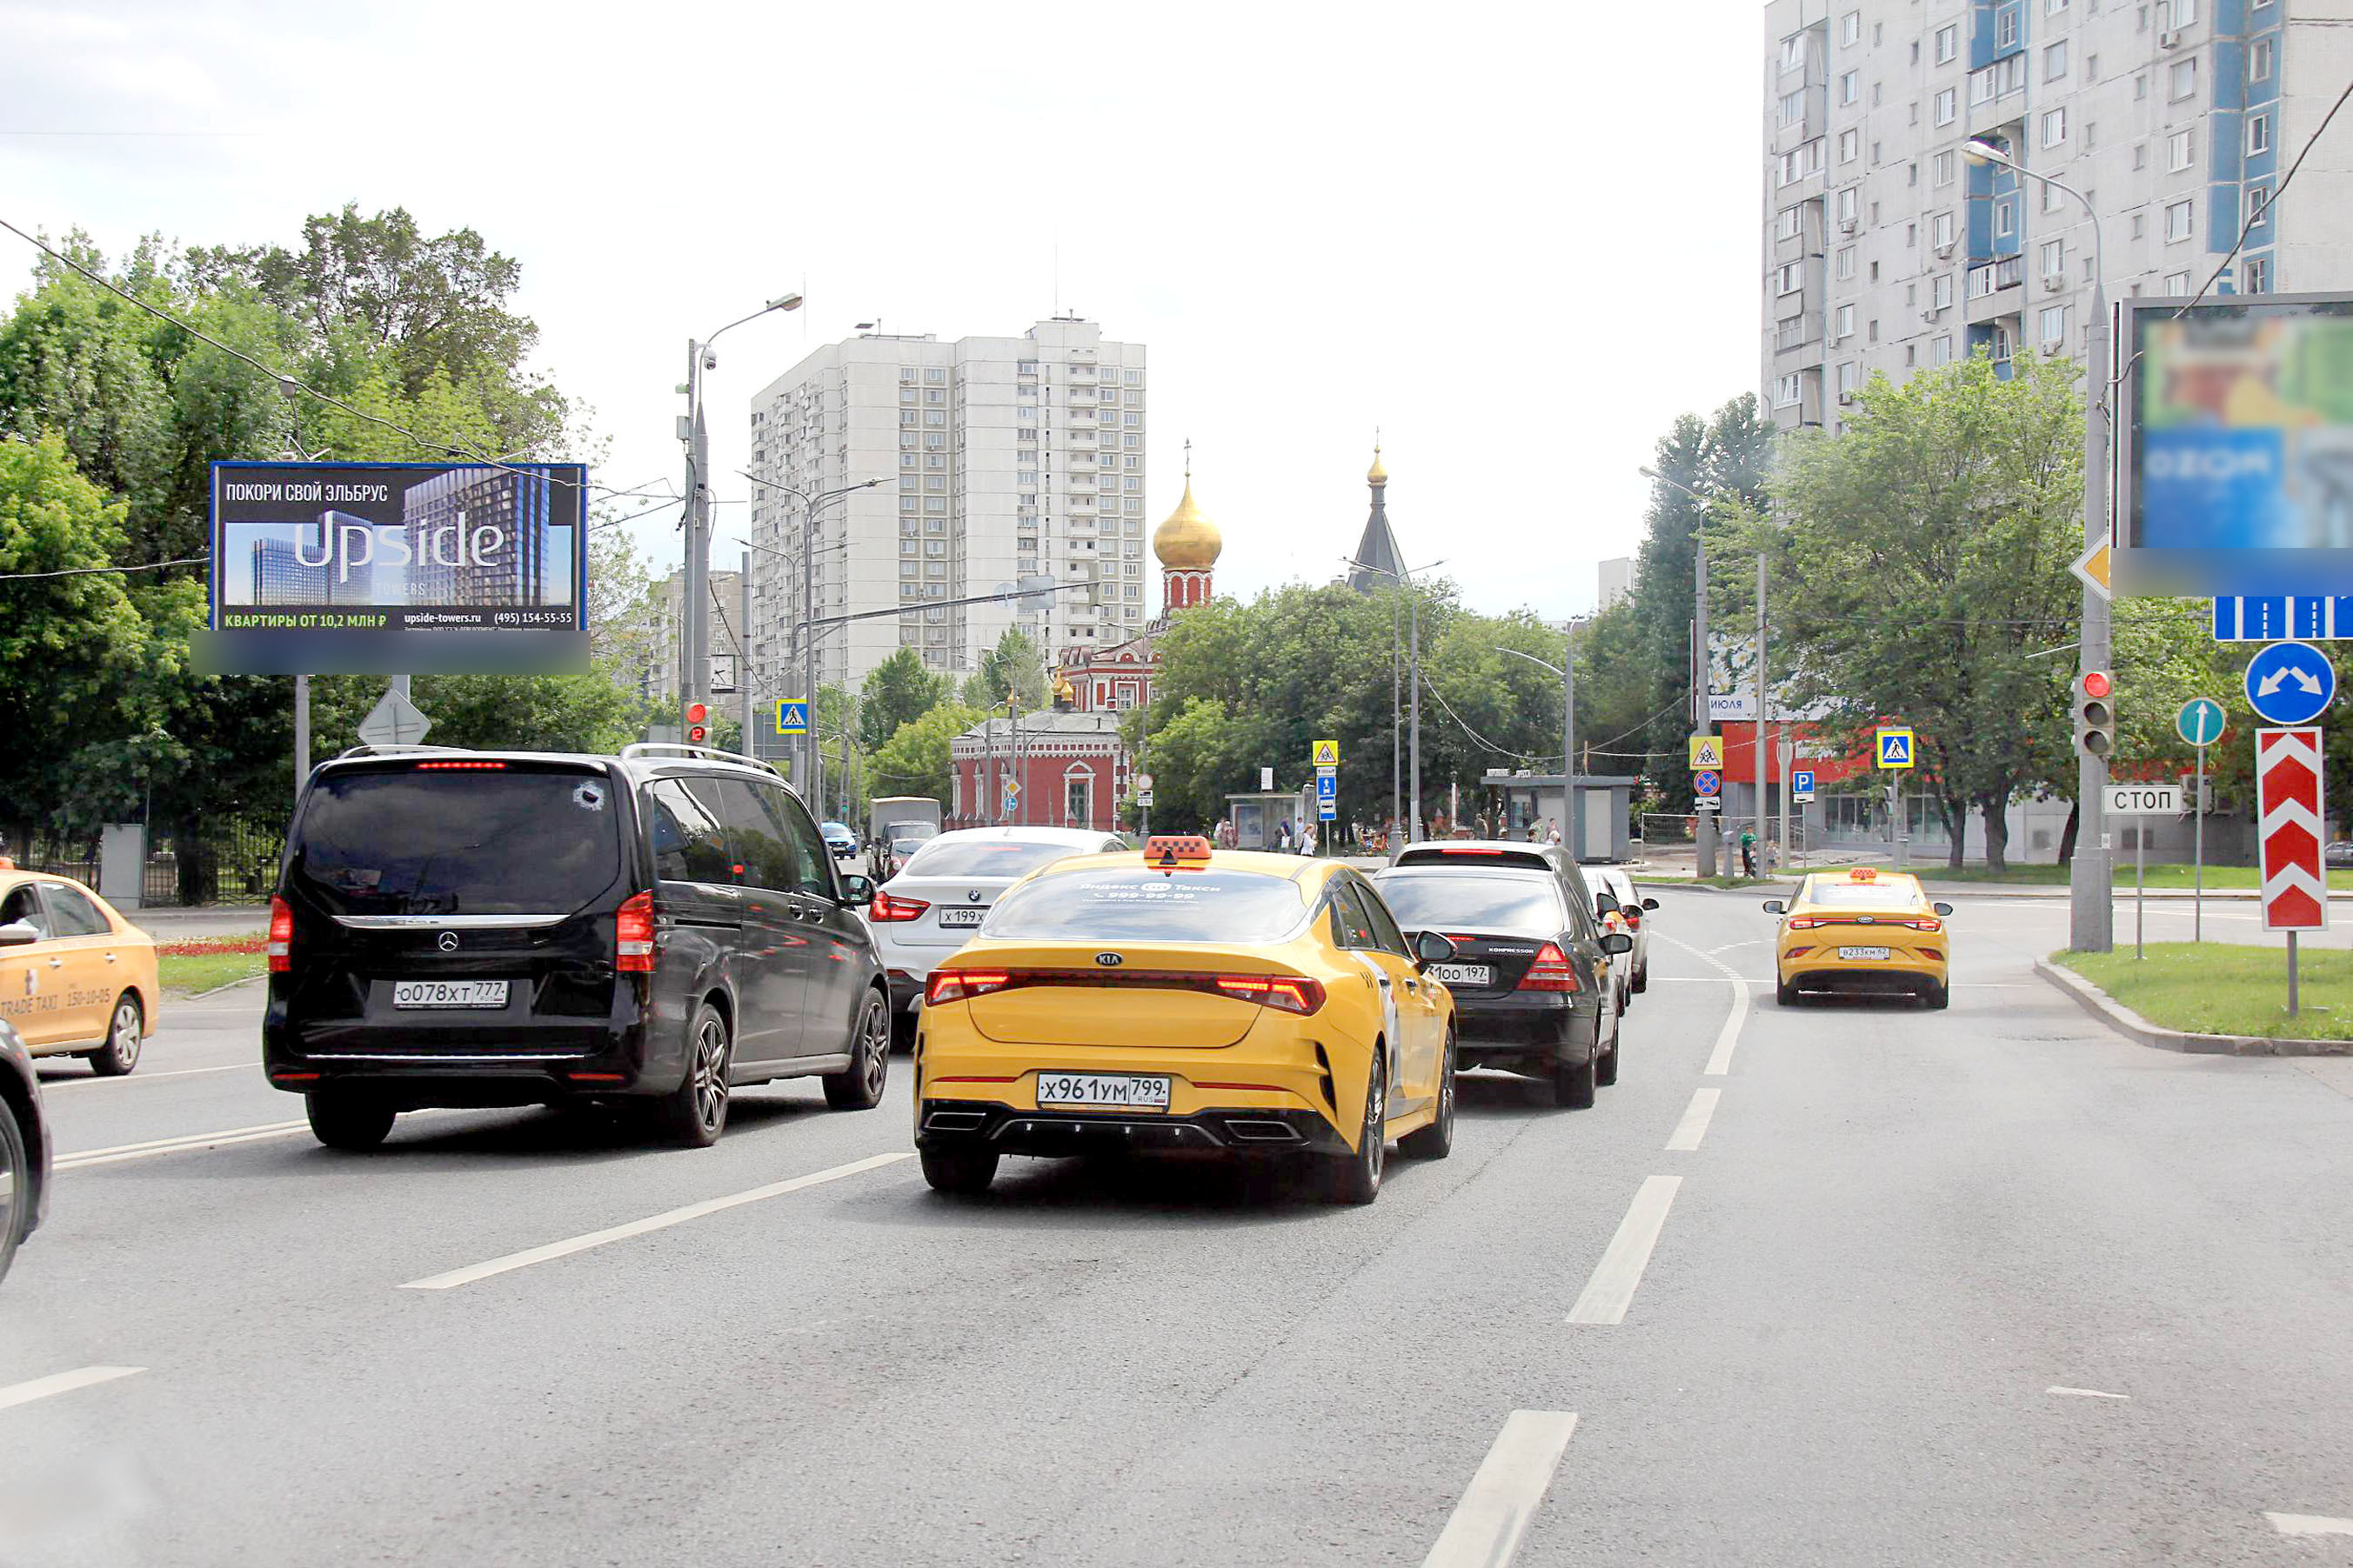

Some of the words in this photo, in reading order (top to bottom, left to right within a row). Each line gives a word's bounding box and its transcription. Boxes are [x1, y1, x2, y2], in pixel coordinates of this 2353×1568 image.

[226, 484, 282, 501] ПОКОРИ
[285, 482, 322, 502] СВОЙ
[325, 484, 388, 502] ЭЛЬБРУС
[294, 510, 505, 584] Upside
[224, 614, 297, 627] КВАРТИРЫ
[300, 614, 318, 627] ОТ
[320, 614, 344, 629] 10,2
[348, 615, 376, 627] МЛН
[404, 612, 481, 624] upside-towers.ru
[494, 612, 520, 624] (495)
[523, 612, 572, 624] 154-55-55
[1710, 699, 1742, 710] ИЮЛЯ
[2115, 791, 2170, 809] СТОП
[1174, 883, 1220, 892] Такси
[945, 911, 984, 922] Х199Х
[1099, 955, 1120, 964] KIA
[1465, 967, 1486, 977] 197
[476, 982, 503, 996] 777
[37, 994, 58, 1011] TAXI
[66, 988, 111, 1007] 150-10-05
[1045, 1078, 1127, 1101] Х961УМ
[1131, 1079, 1164, 1096] 799
